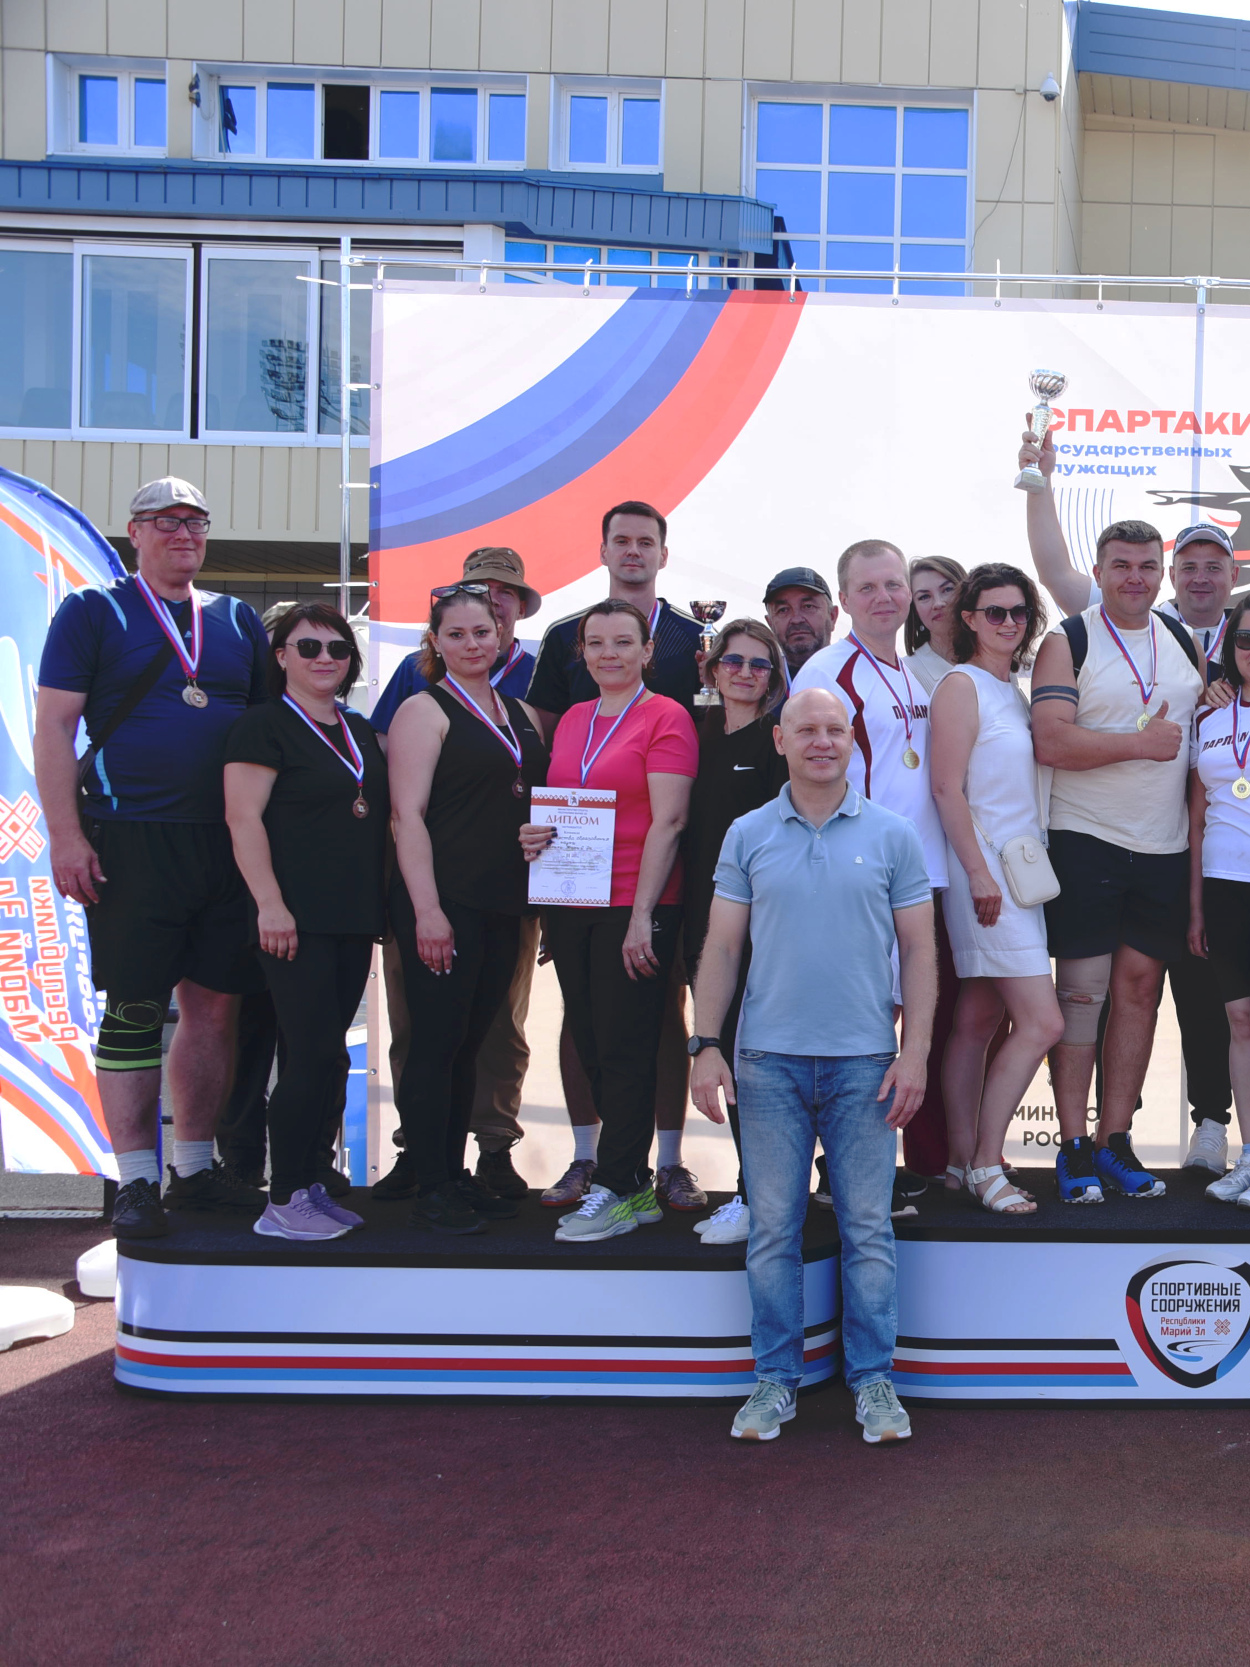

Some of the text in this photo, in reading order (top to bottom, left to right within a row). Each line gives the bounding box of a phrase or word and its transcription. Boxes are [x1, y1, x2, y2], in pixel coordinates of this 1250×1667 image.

[1053, 443, 1232, 458] сударственных
[1054, 463, 1157, 477] лужащих
[545, 814, 600, 826] ДИПЛОМ
[1151, 1282, 1242, 1296] СПОРТИВНЫЕ
[1151, 1299, 1241, 1313] СООРУЖЕНИЯ
[1160, 1317, 1206, 1326] Республики
[1160, 1326, 1206, 1338] Марий Эл
